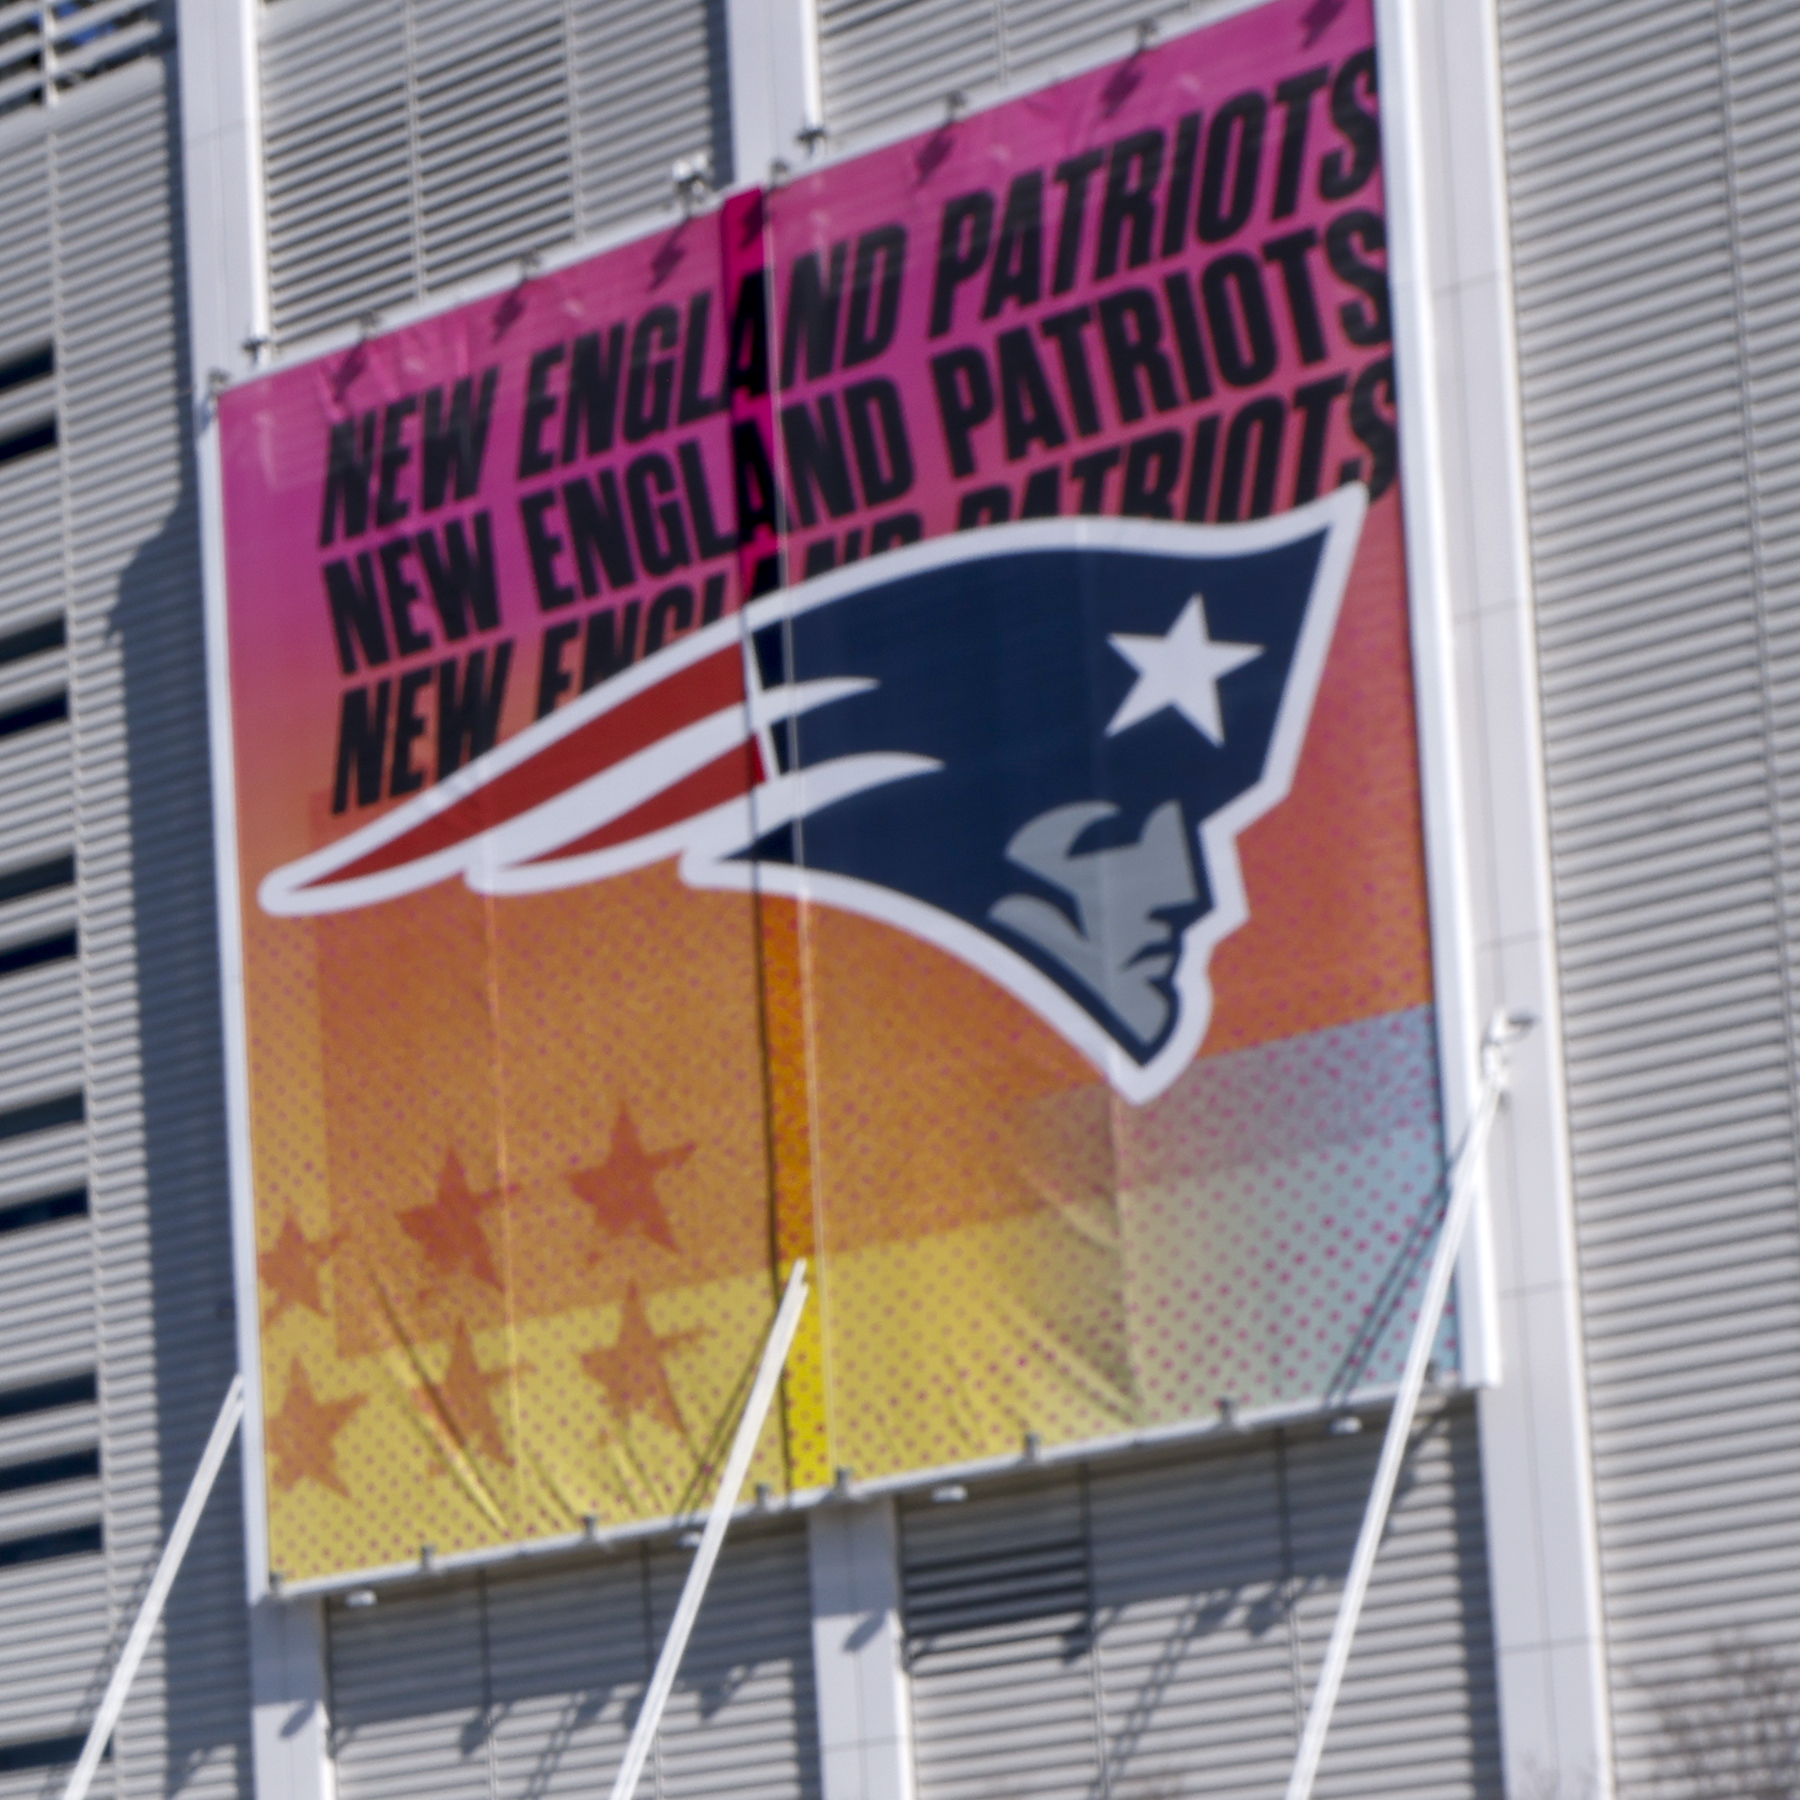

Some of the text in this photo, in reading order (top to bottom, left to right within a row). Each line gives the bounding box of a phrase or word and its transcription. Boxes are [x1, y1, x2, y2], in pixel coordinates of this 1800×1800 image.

[319, 45, 1381, 549] NEW ENGLAND PATRIOTS
[321, 509, 502, 677] NEW
[518, 376, 915, 614] ENGLAND
[930, 207, 1393, 479] PATRIOTS
[331, 637, 514, 816] NEW
